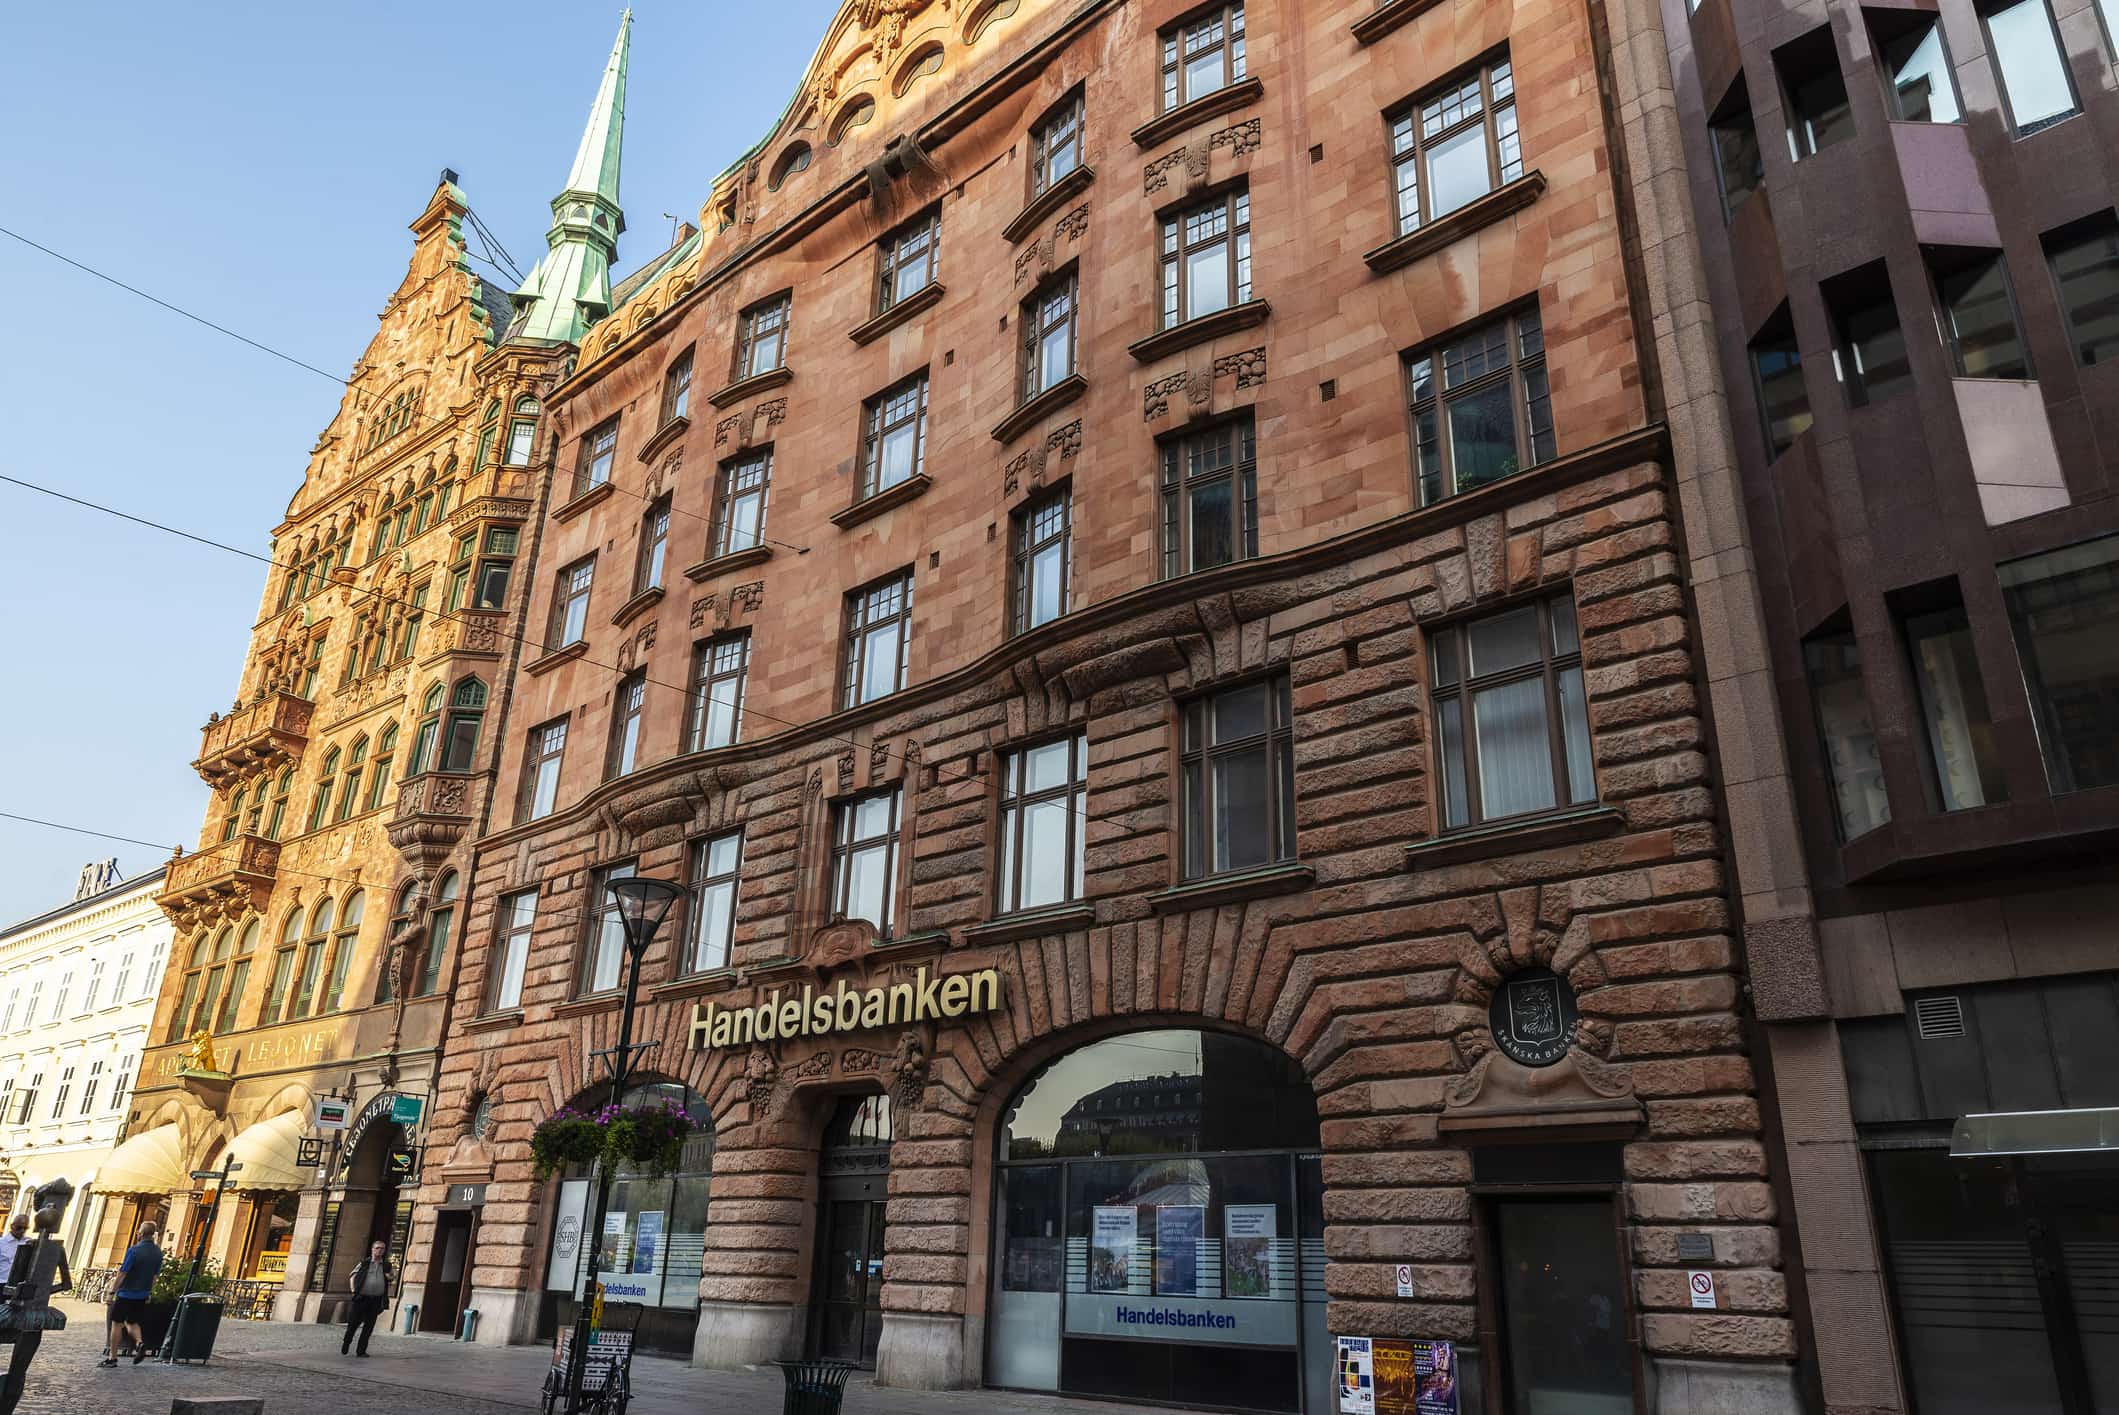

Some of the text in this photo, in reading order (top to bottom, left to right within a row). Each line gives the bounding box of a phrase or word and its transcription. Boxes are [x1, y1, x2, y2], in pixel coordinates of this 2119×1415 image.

[687, 967, 998, 1050] Handelsbanken
[248, 1030, 339, 1063] LEJONET
[462, 1187, 474, 1201] 10
[605, 1282, 646, 1297] delsbanken
[1116, 1306, 1236, 1328] Handelsbanken
